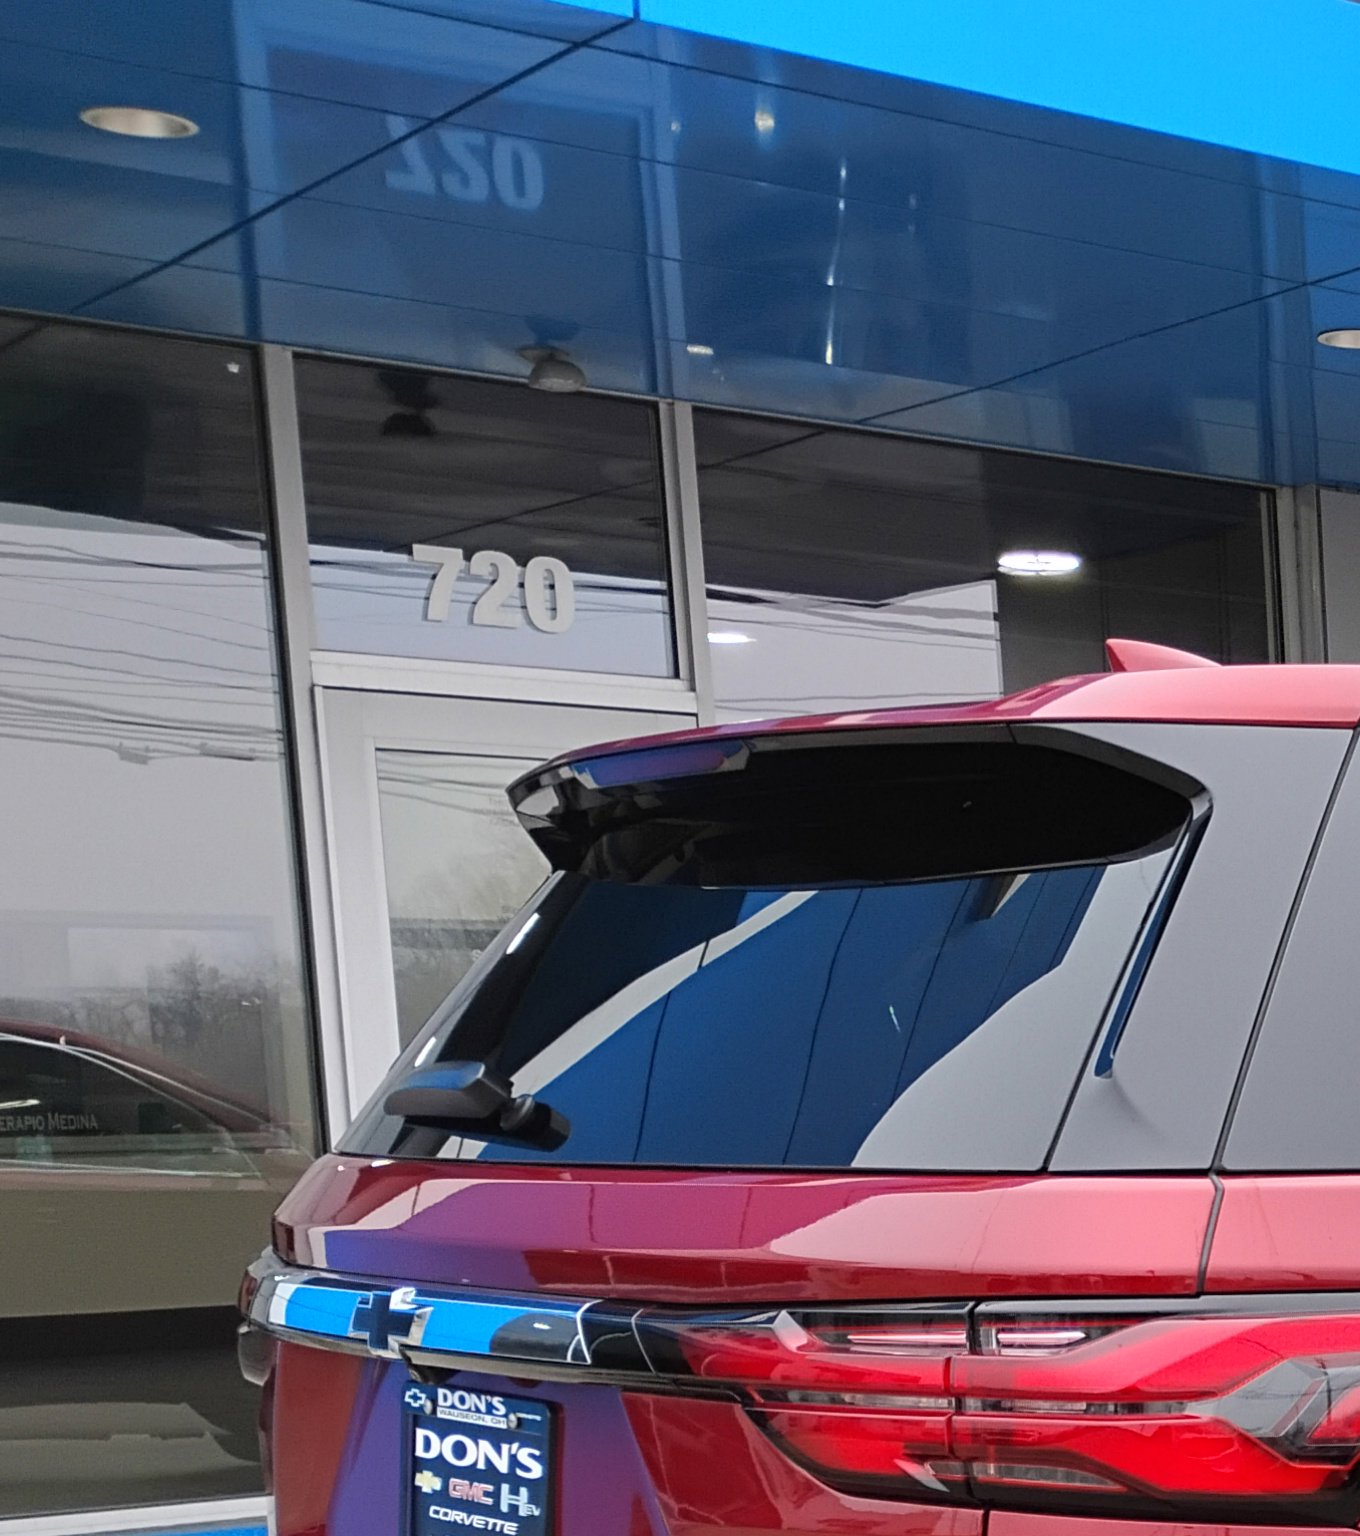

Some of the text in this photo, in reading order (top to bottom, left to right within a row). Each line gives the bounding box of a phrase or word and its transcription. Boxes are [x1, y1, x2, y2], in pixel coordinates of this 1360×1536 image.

[411, 543, 576, 634] 720
[47, 1111, 98, 1130] MEDINA
[437, 1387, 507, 1416] DON'S
[414, 1427, 543, 1480] DON'S
[448, 1477, 494, 1505] GMC
[428, 1505, 519, 1535] CORVETTE
